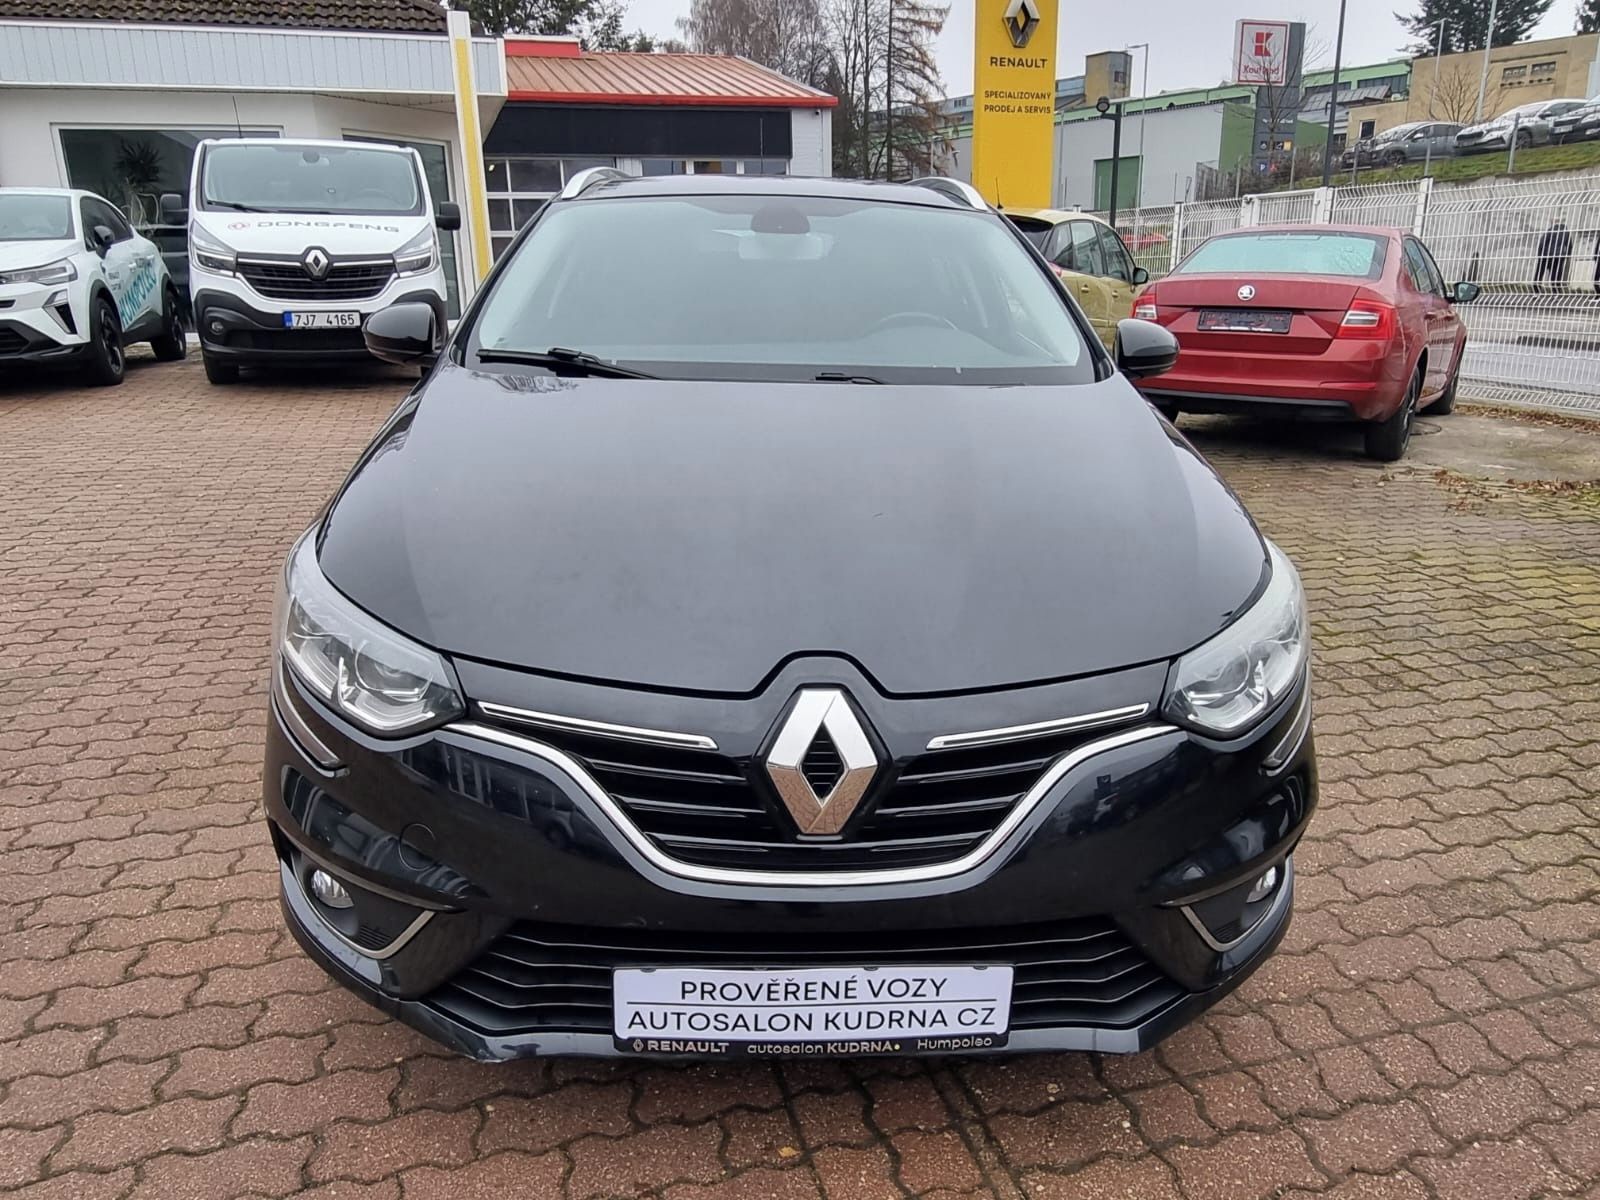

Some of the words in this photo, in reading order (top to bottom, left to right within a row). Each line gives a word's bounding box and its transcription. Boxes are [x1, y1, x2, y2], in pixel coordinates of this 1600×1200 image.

[989, 56, 1048, 69] RENAULT
[984, 104, 1016, 113] PRODEJ
[1017, 105, 1023, 113] A
[1024, 105, 1051, 114] SERVIS
[257, 221, 400, 233] DONGFENG
[295, 314, 317, 326] 7J7
[326, 314, 355, 326] 4165
[680, 975, 858, 1002] PROVĚŘENÉ
[866, 978, 948, 999] VOZY
[627, 1010, 813, 1032] AUTOSALON
[824, 1008, 948, 1031] KUDRNA
[957, 1007, 996, 1026] CZ
[647, 1040, 730, 1054] RENAULT
[747, 1042, 824, 1054] autosalon
[827, 1040, 894, 1054] KUDRNA
